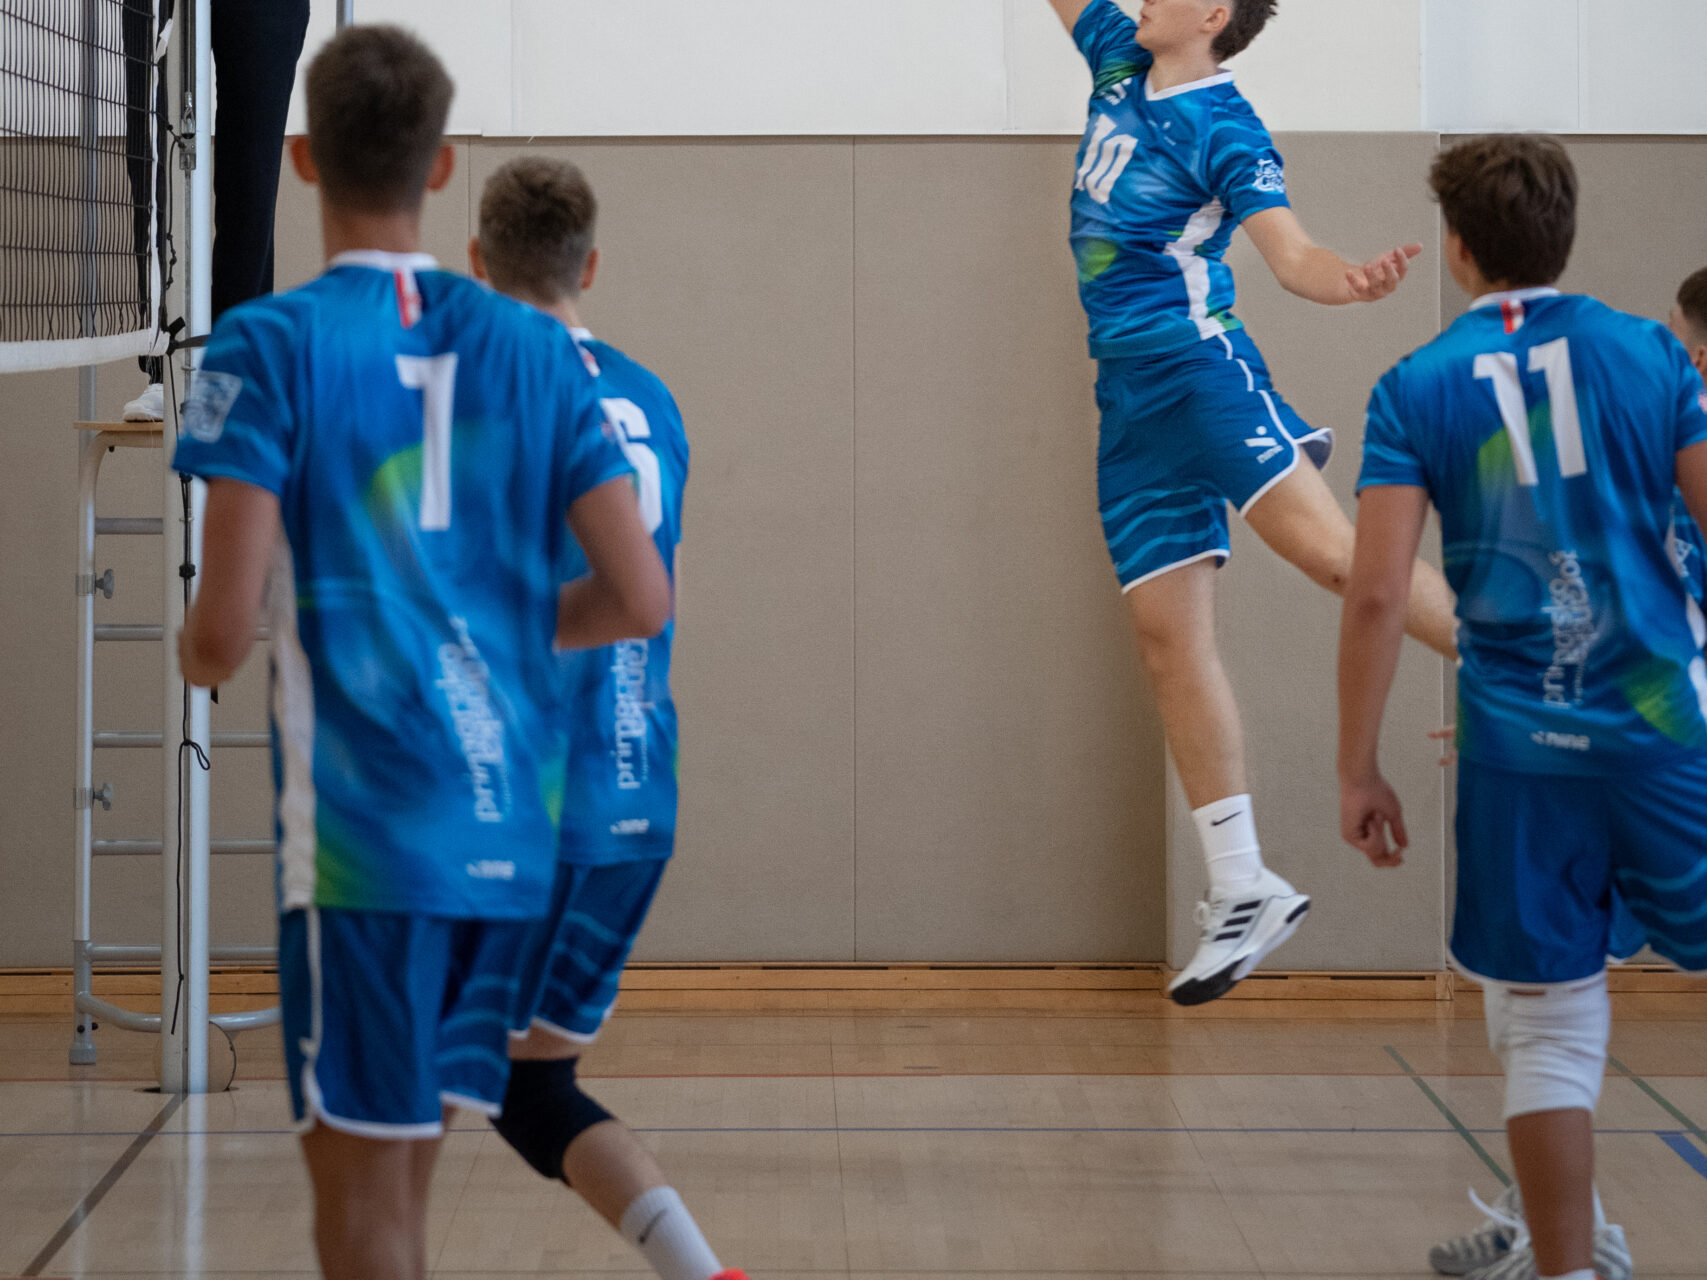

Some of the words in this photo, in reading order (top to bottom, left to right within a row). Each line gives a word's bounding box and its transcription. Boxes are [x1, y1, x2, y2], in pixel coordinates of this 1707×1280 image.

[1074, 113, 1139, 205] 10
[395, 351, 459, 532] 1
[1472, 336, 1587, 486] 11
